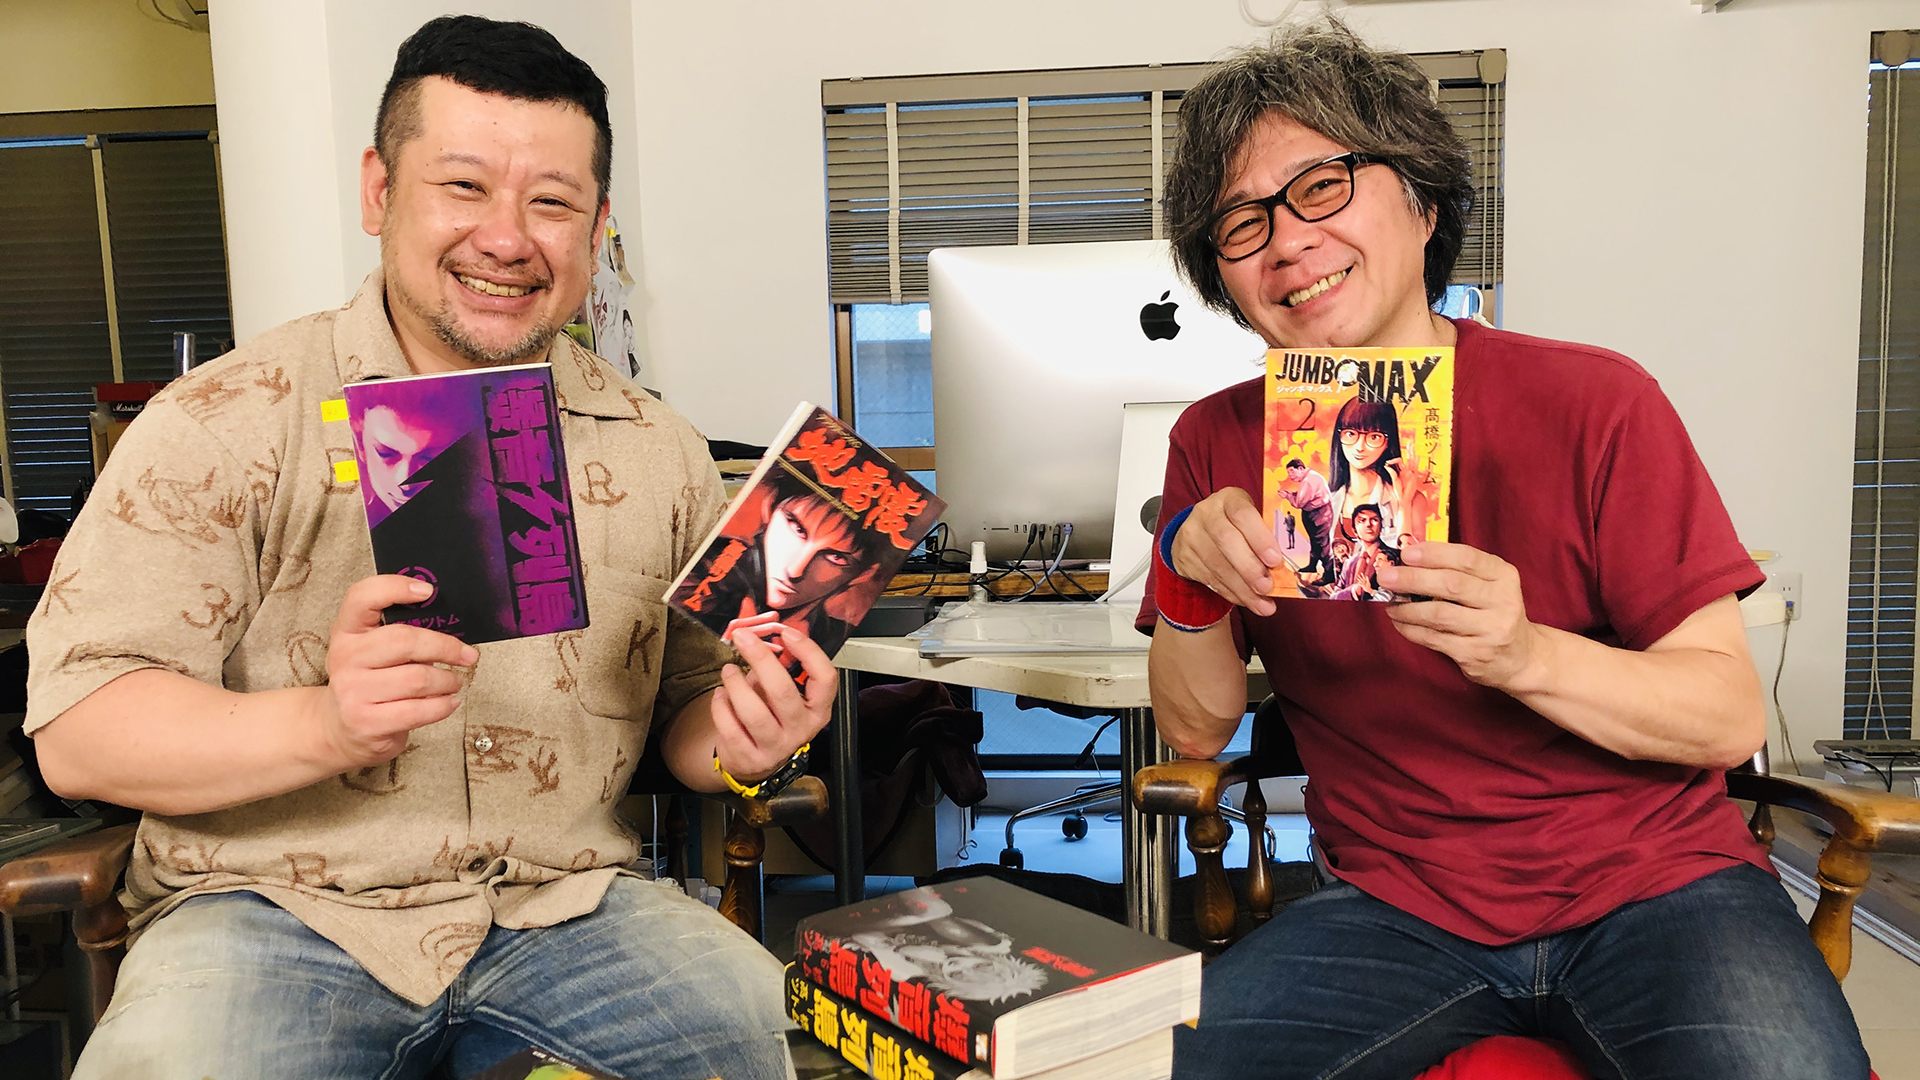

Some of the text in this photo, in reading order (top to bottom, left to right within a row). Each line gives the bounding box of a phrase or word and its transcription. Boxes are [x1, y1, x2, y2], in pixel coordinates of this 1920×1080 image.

[1295, 398, 1315, 431] 2
[828, 940, 970, 1064] 爆音列島
